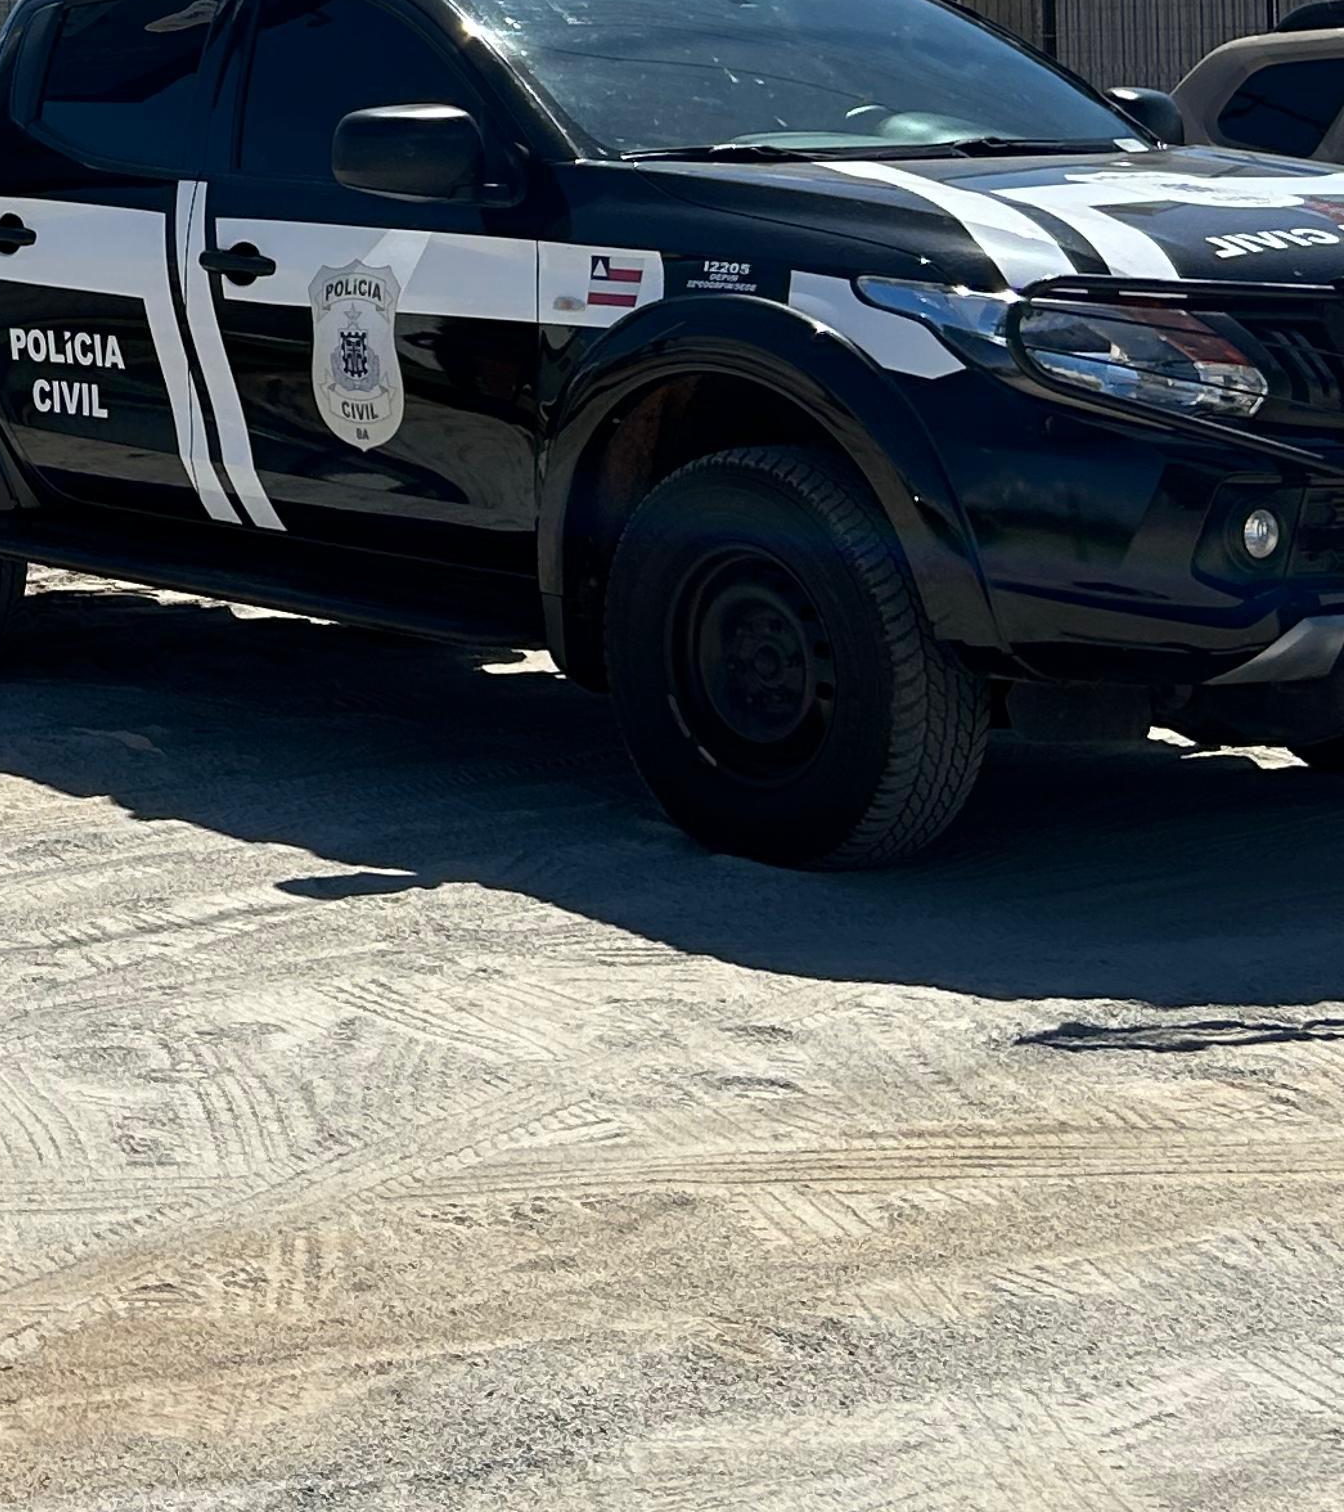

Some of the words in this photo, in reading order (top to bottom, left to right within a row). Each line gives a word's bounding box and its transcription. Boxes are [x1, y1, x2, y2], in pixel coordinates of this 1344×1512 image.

[325, 278, 383, 302] POLÍCIA
[9, 327, 126, 370] POLÍCIA
[32, 378, 109, 419] CIVIL
[341, 400, 379, 420] CIVIL
[355, 427, 370, 441] BA
